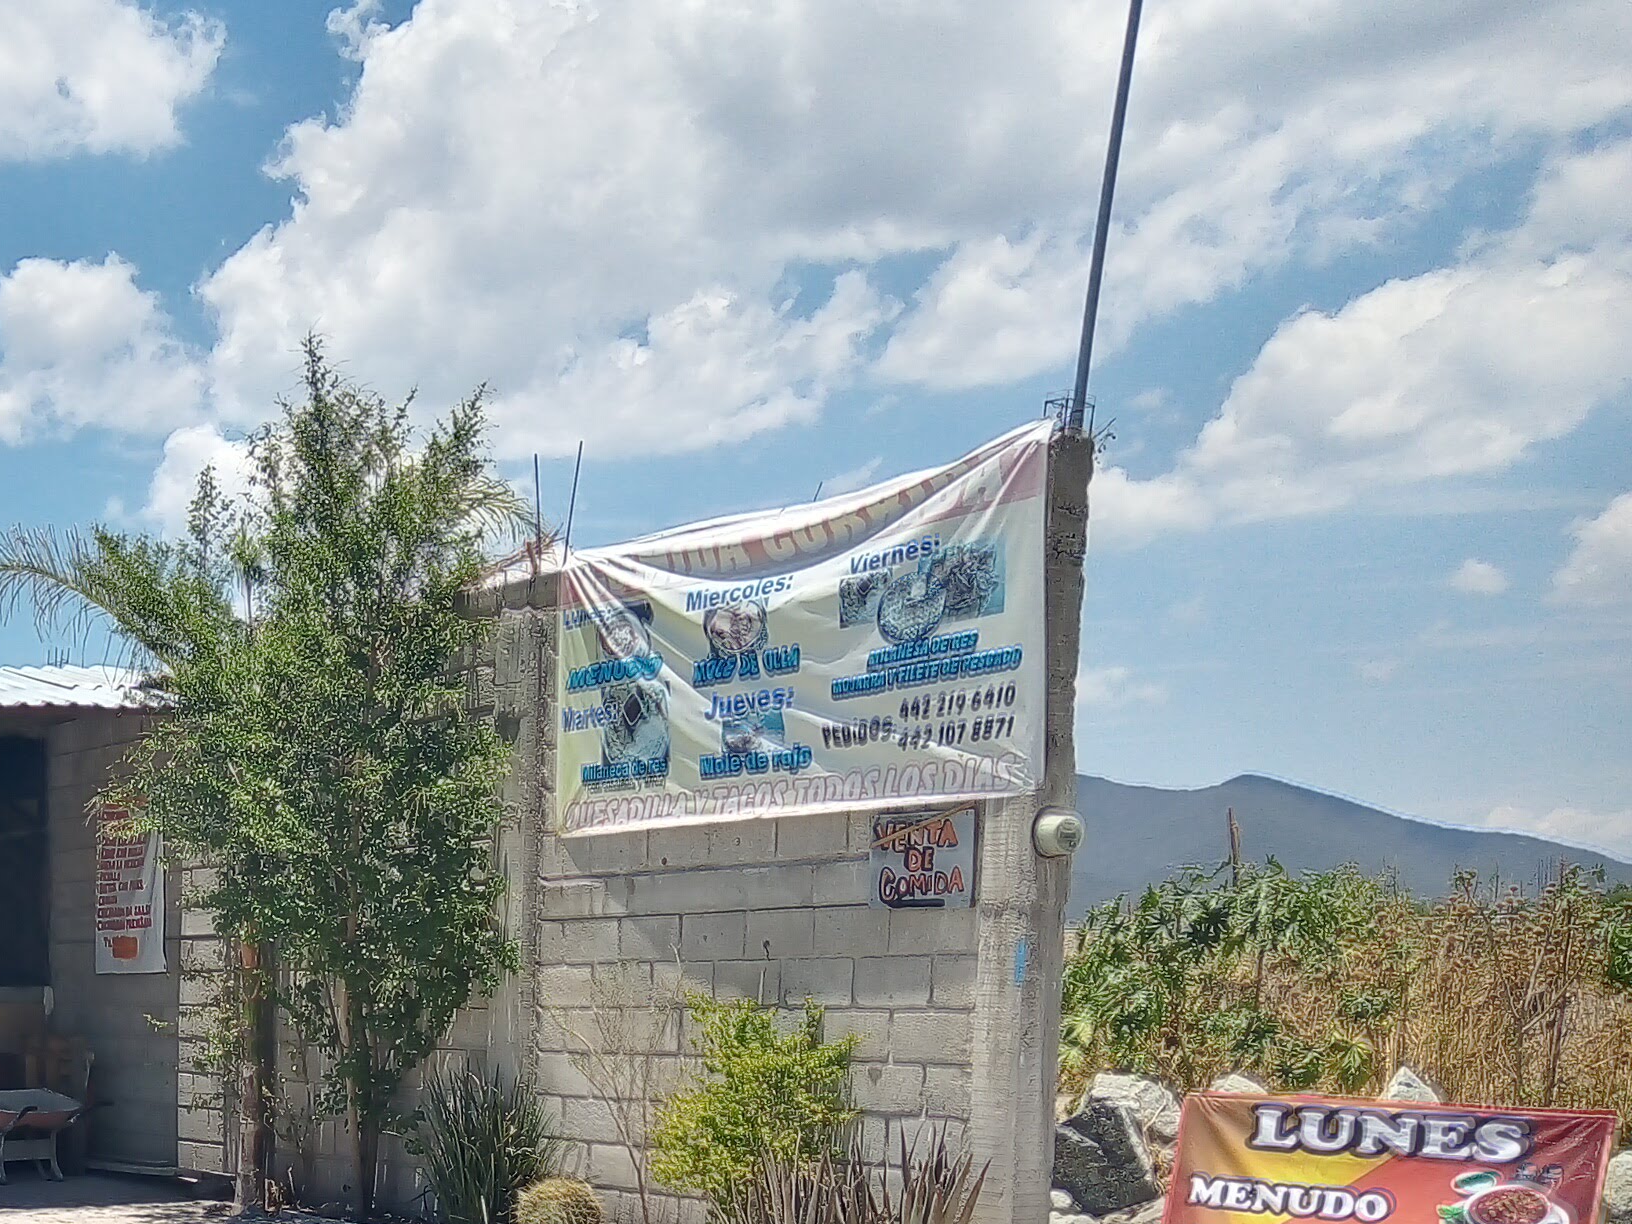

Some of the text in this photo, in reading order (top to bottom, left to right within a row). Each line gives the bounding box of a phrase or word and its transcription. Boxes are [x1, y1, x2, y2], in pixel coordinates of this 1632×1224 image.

[850, 534, 941, 572] Viernes:
[686, 574, 793, 612] Miercoles:
[738, 650, 760, 678] DE
[762, 643, 800, 674] OLLA
[868, 630, 979, 667] MILANESA DE RES
[566, 652, 664, 694] MENUDO
[831, 643, 1023, 700] MOJARRA Y FILETE DE PESCADO
[562, 704, 617, 731] Martes:
[705, 687, 795, 720] Jueves:
[899, 680, 1016, 721] 442 219 6410
[898, 724, 932, 751] 442
[938, 720, 966, 746] 107
[971, 712, 1015, 742] 8871
[631, 759, 646, 776] de
[648, 757, 668, 776] res
[699, 753, 742, 780] Mole
[744, 752, 769, 775] de
[687, 786, 709, 817] Y
[711, 777, 790, 816] TACOS
[788, 769, 880, 805] TODOS
[885, 762, 938, 799] LOS
[942, 754, 1018, 797] DIAS
[876, 816, 958, 851] VENTA
[904, 847, 934, 871] DE
[879, 867, 964, 901] COMIDA
[1250, 1103, 1528, 1164] LUNES
[1188, 1174, 1392, 1223] MENUDO
